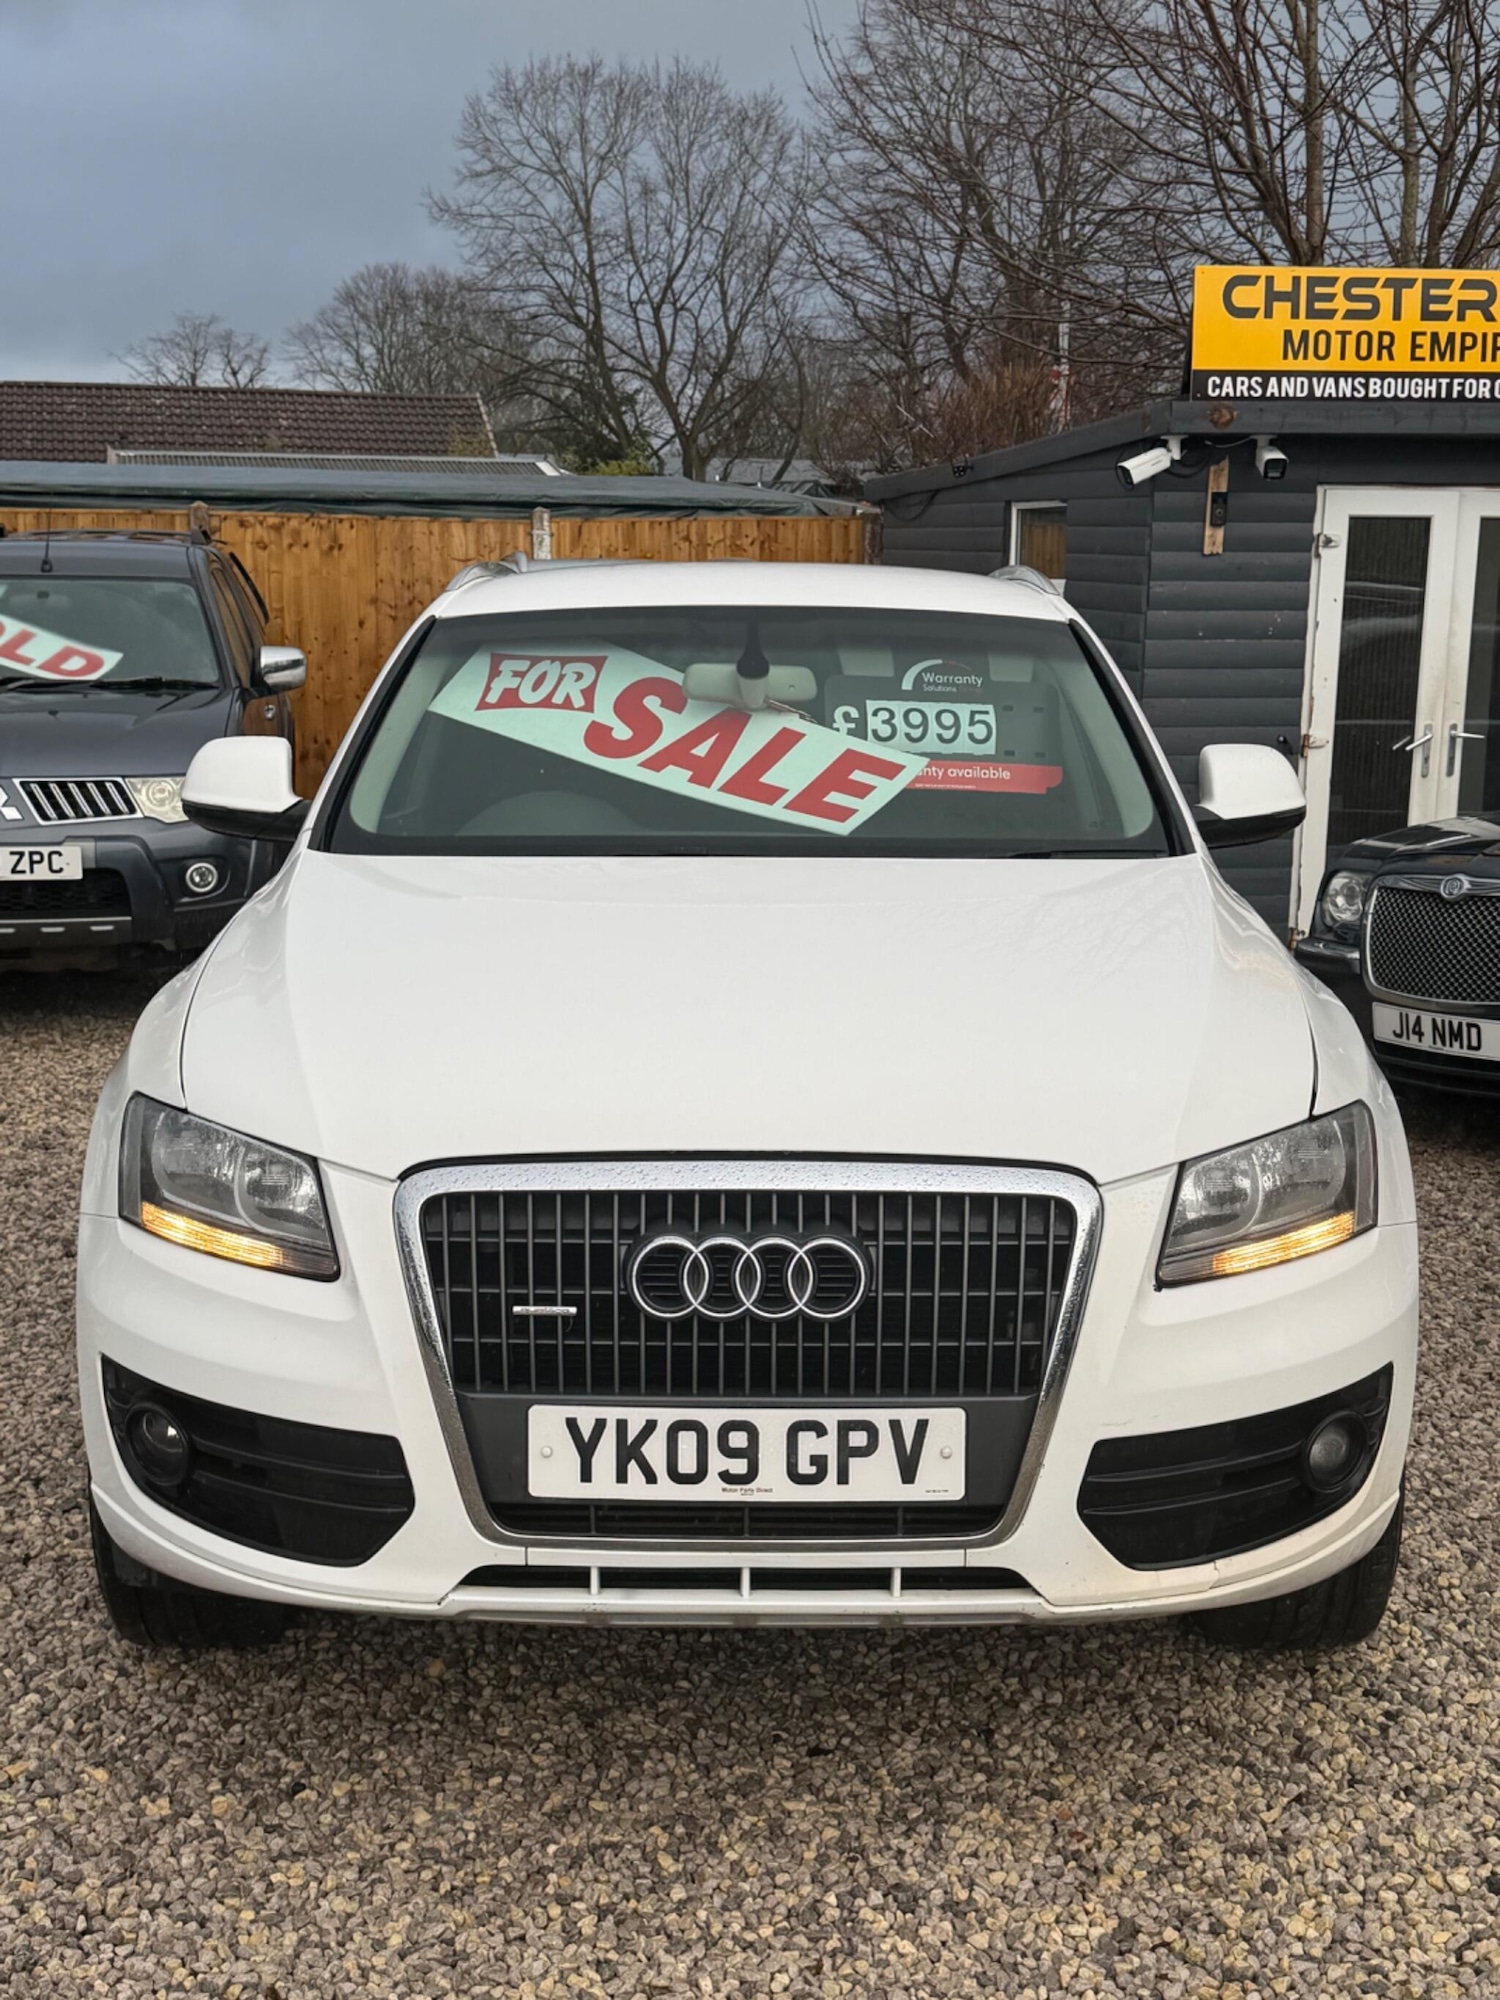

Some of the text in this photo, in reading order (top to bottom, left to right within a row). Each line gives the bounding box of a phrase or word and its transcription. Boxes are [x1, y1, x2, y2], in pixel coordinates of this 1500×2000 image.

[1222, 274, 1498, 322] CHESTER
[1282, 329, 1395, 361] MOTOR
[1207, 376, 1262, 398] CARS
[1266, 377, 1309, 398] AND
[1312, 377, 1366, 398] VANS
[1369, 377, 1450, 399] BOUGHT
[1452, 378, 1491, 399] FOR
[0, 620, 105, 678] LD
[921, 672, 983, 688] Warranty
[483, 658, 907, 824] FOR SALE
[832, 704, 994, 745] £3995
[947, 766, 1011, 780] available
[9, 850, 64, 875] ZPC
[1392, 1011, 1482, 1051] J14 NMD
[564, 1416, 931, 1486] YK09 GPV
